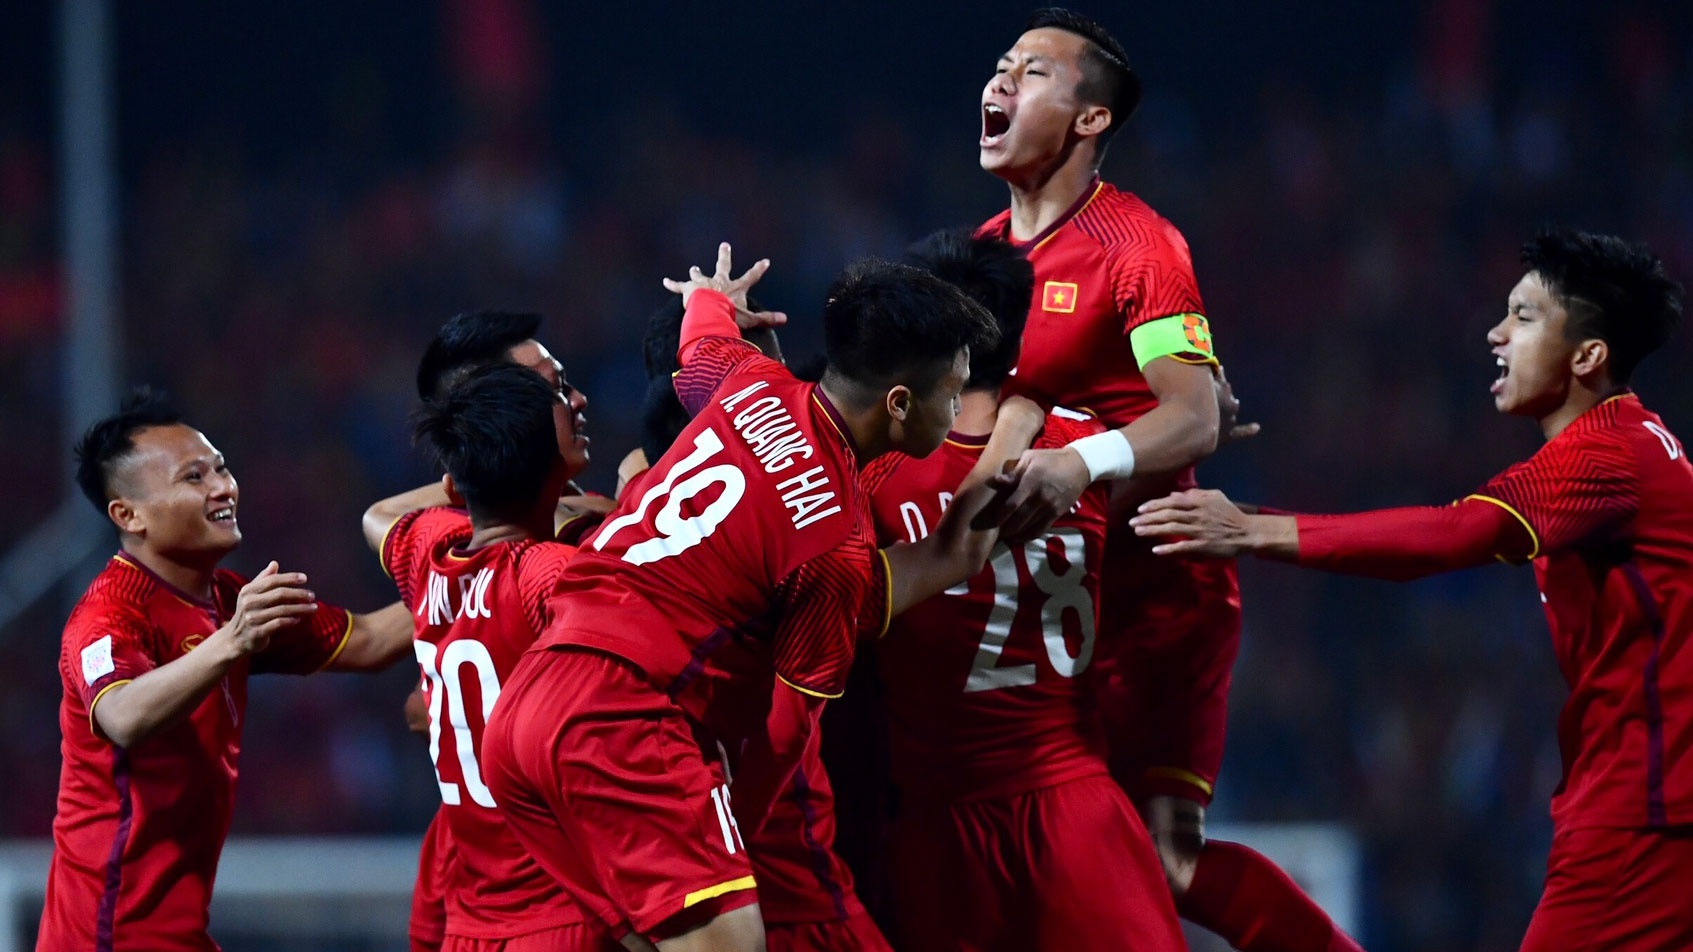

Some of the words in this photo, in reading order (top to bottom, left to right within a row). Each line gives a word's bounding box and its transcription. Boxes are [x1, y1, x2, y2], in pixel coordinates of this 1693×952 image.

[592, 426, 747, 567] 19
[733, 396, 814, 474] QUANG
[775, 465, 842, 530] HAI
[944, 526, 1096, 692] 28
[413, 638, 502, 808] 20
